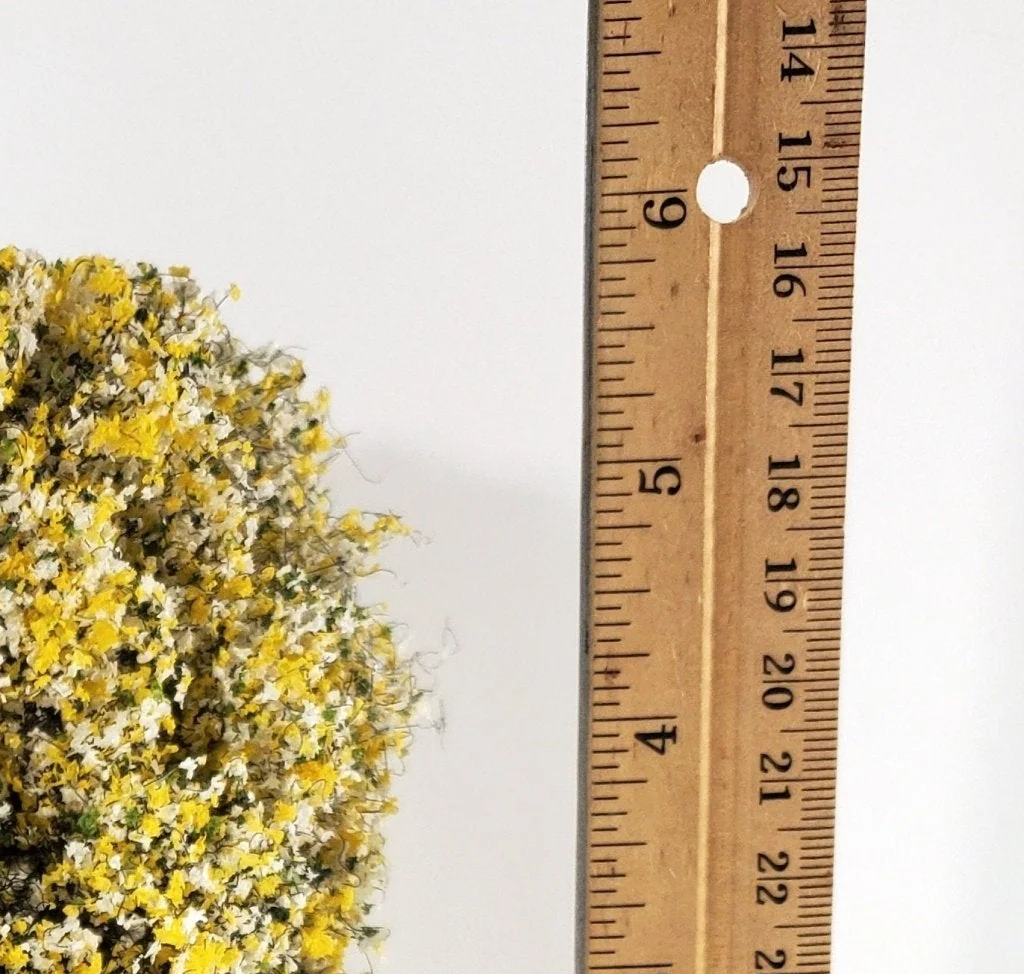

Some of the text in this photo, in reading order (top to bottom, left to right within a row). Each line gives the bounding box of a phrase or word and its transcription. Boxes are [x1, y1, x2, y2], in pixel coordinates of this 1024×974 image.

[780, 18, 816, 82] 14
[777, 130, 813, 192] 15
[643, 197, 687, 229] 6
[773, 243, 807, 298] 16
[770, 347, 805, 406] 17
[639, 465, 681, 495] 5
[767, 454, 801, 513] 18
[764, 558, 798, 613] 19
[762, 653, 795, 710] 20
[635, 724, 677, 754] 4
[759, 752, 792, 805] 21
[756, 851, 790, 905] 22
